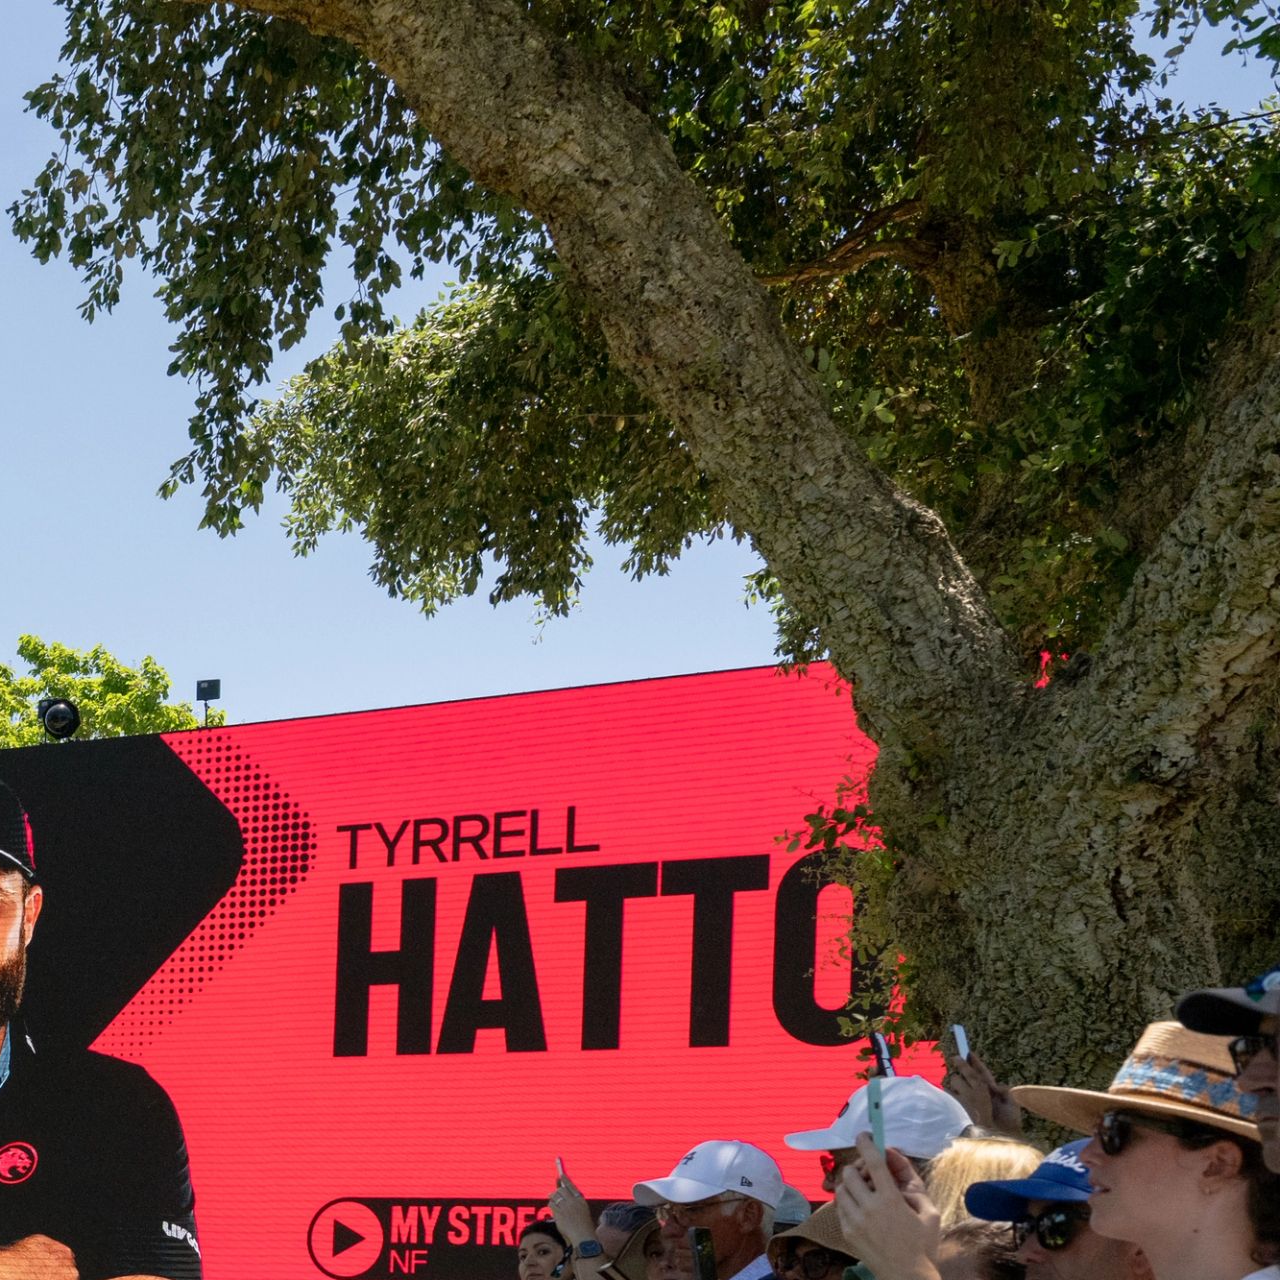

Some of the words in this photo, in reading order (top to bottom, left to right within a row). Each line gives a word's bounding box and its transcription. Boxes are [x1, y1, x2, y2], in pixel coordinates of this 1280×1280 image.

[336, 806, 600, 869] TYRRELL
[333, 846, 887, 1057] HATTO
[390, 1206, 442, 1244] MY
[390, 1249, 428, 1274] NF
